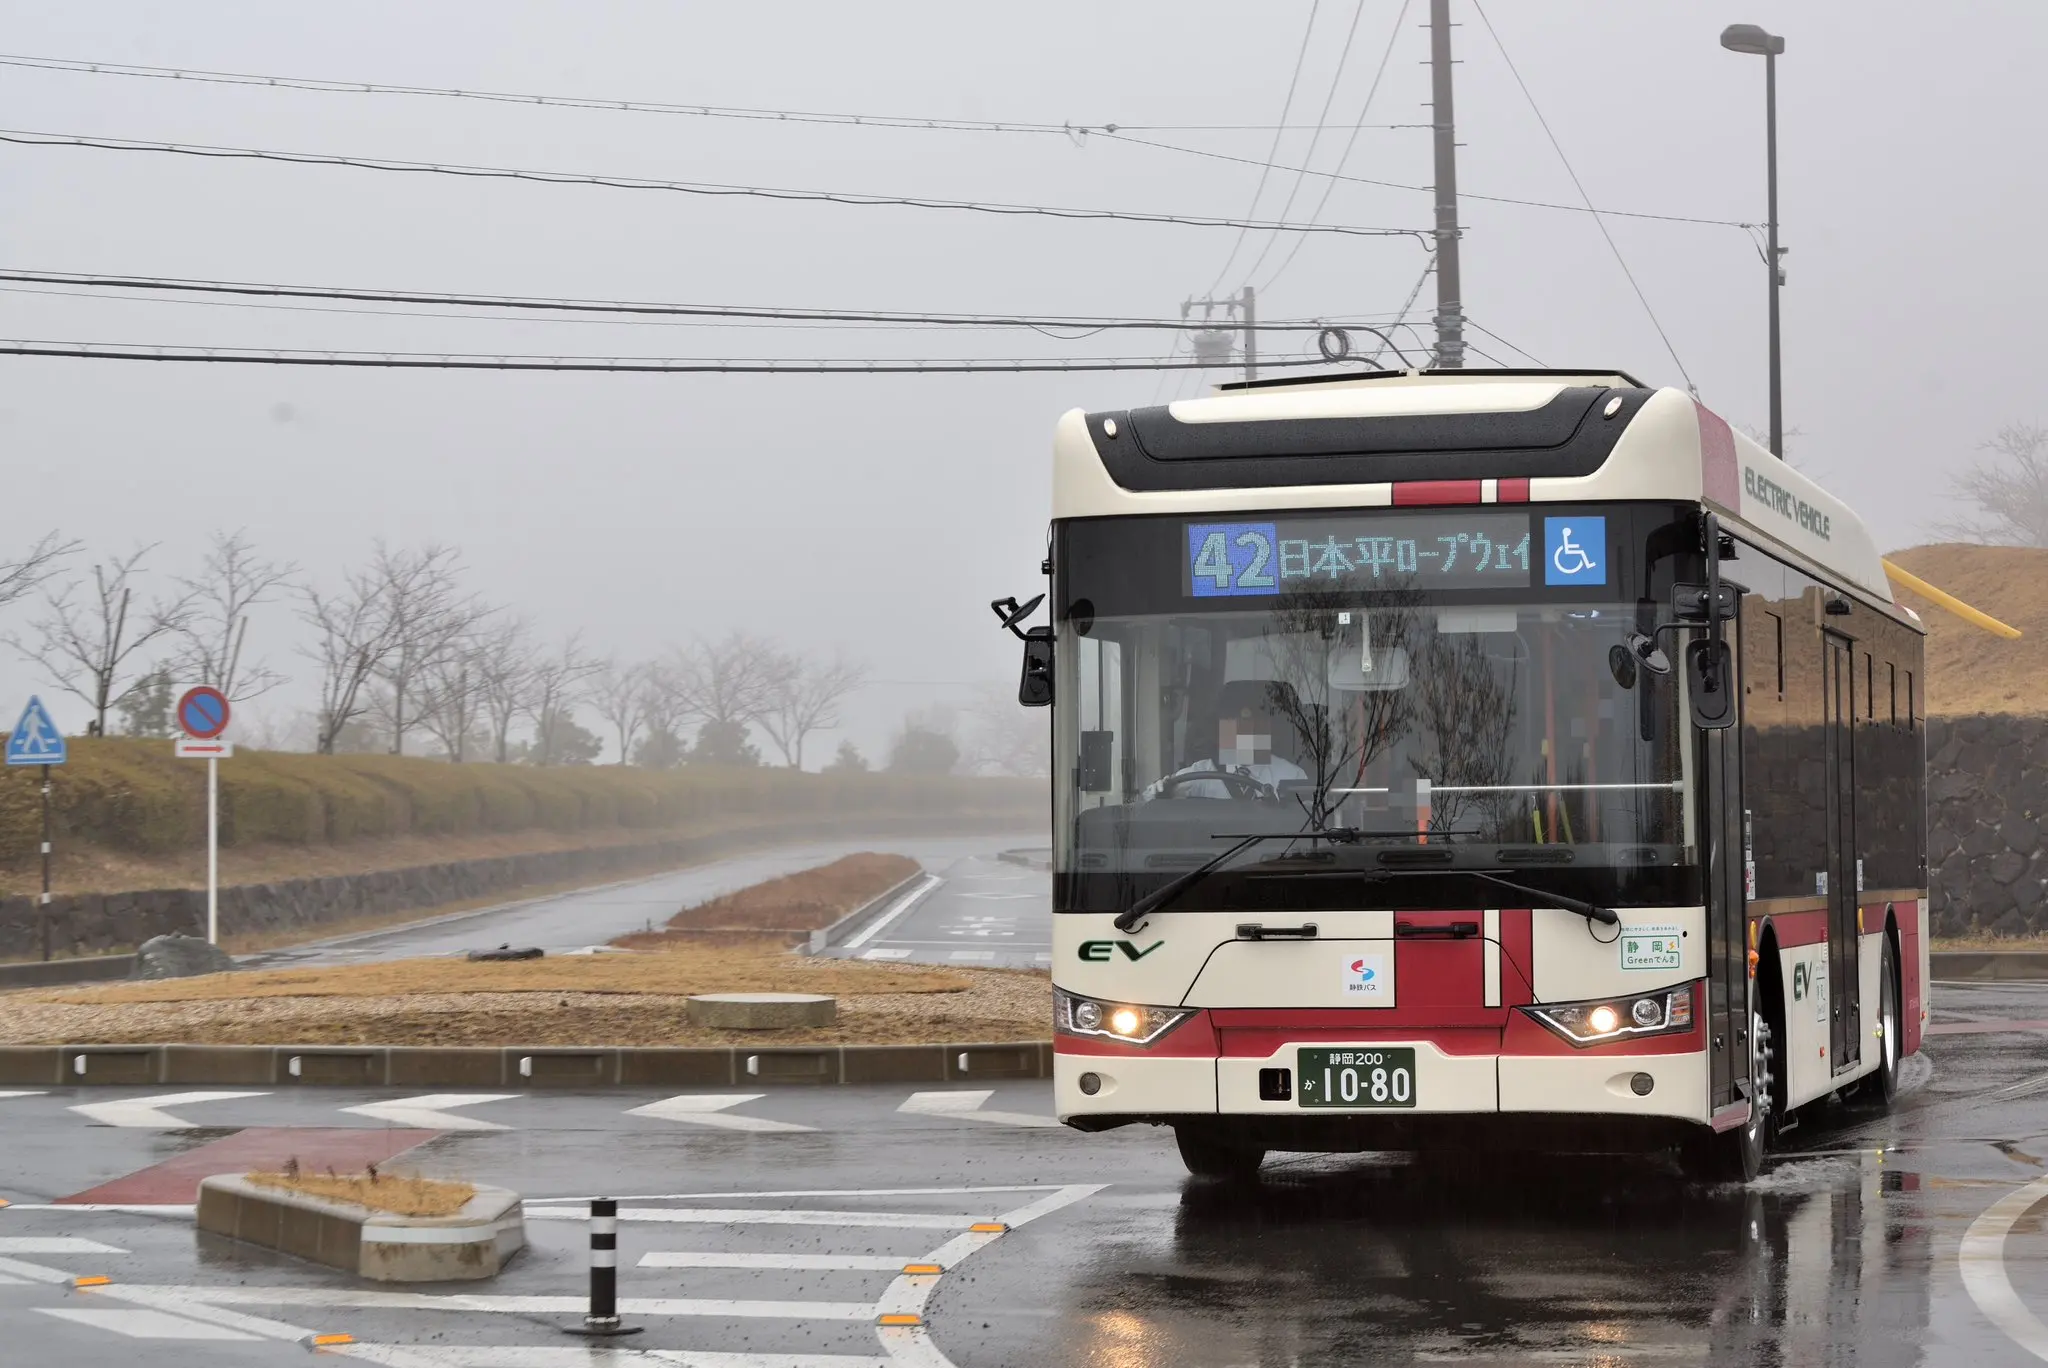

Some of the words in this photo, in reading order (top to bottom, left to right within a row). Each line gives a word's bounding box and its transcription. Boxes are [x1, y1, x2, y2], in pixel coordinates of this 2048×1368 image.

[1745, 466, 1792, 520] ELECTRIC
[1792, 494, 1830, 541] VEHICLE
[1194, 531, 1275, 588] 42
[1279, 532, 1530, 579] 日本平ロープウェイ
[1078, 940, 1165, 962] EV
[1627, 955, 1675, 964] Greenでんき
[1794, 960, 1813, 1002] EV
[1304, 1080, 1316, 1091] か
[1324, 1068, 1410, 1102] 10-80
